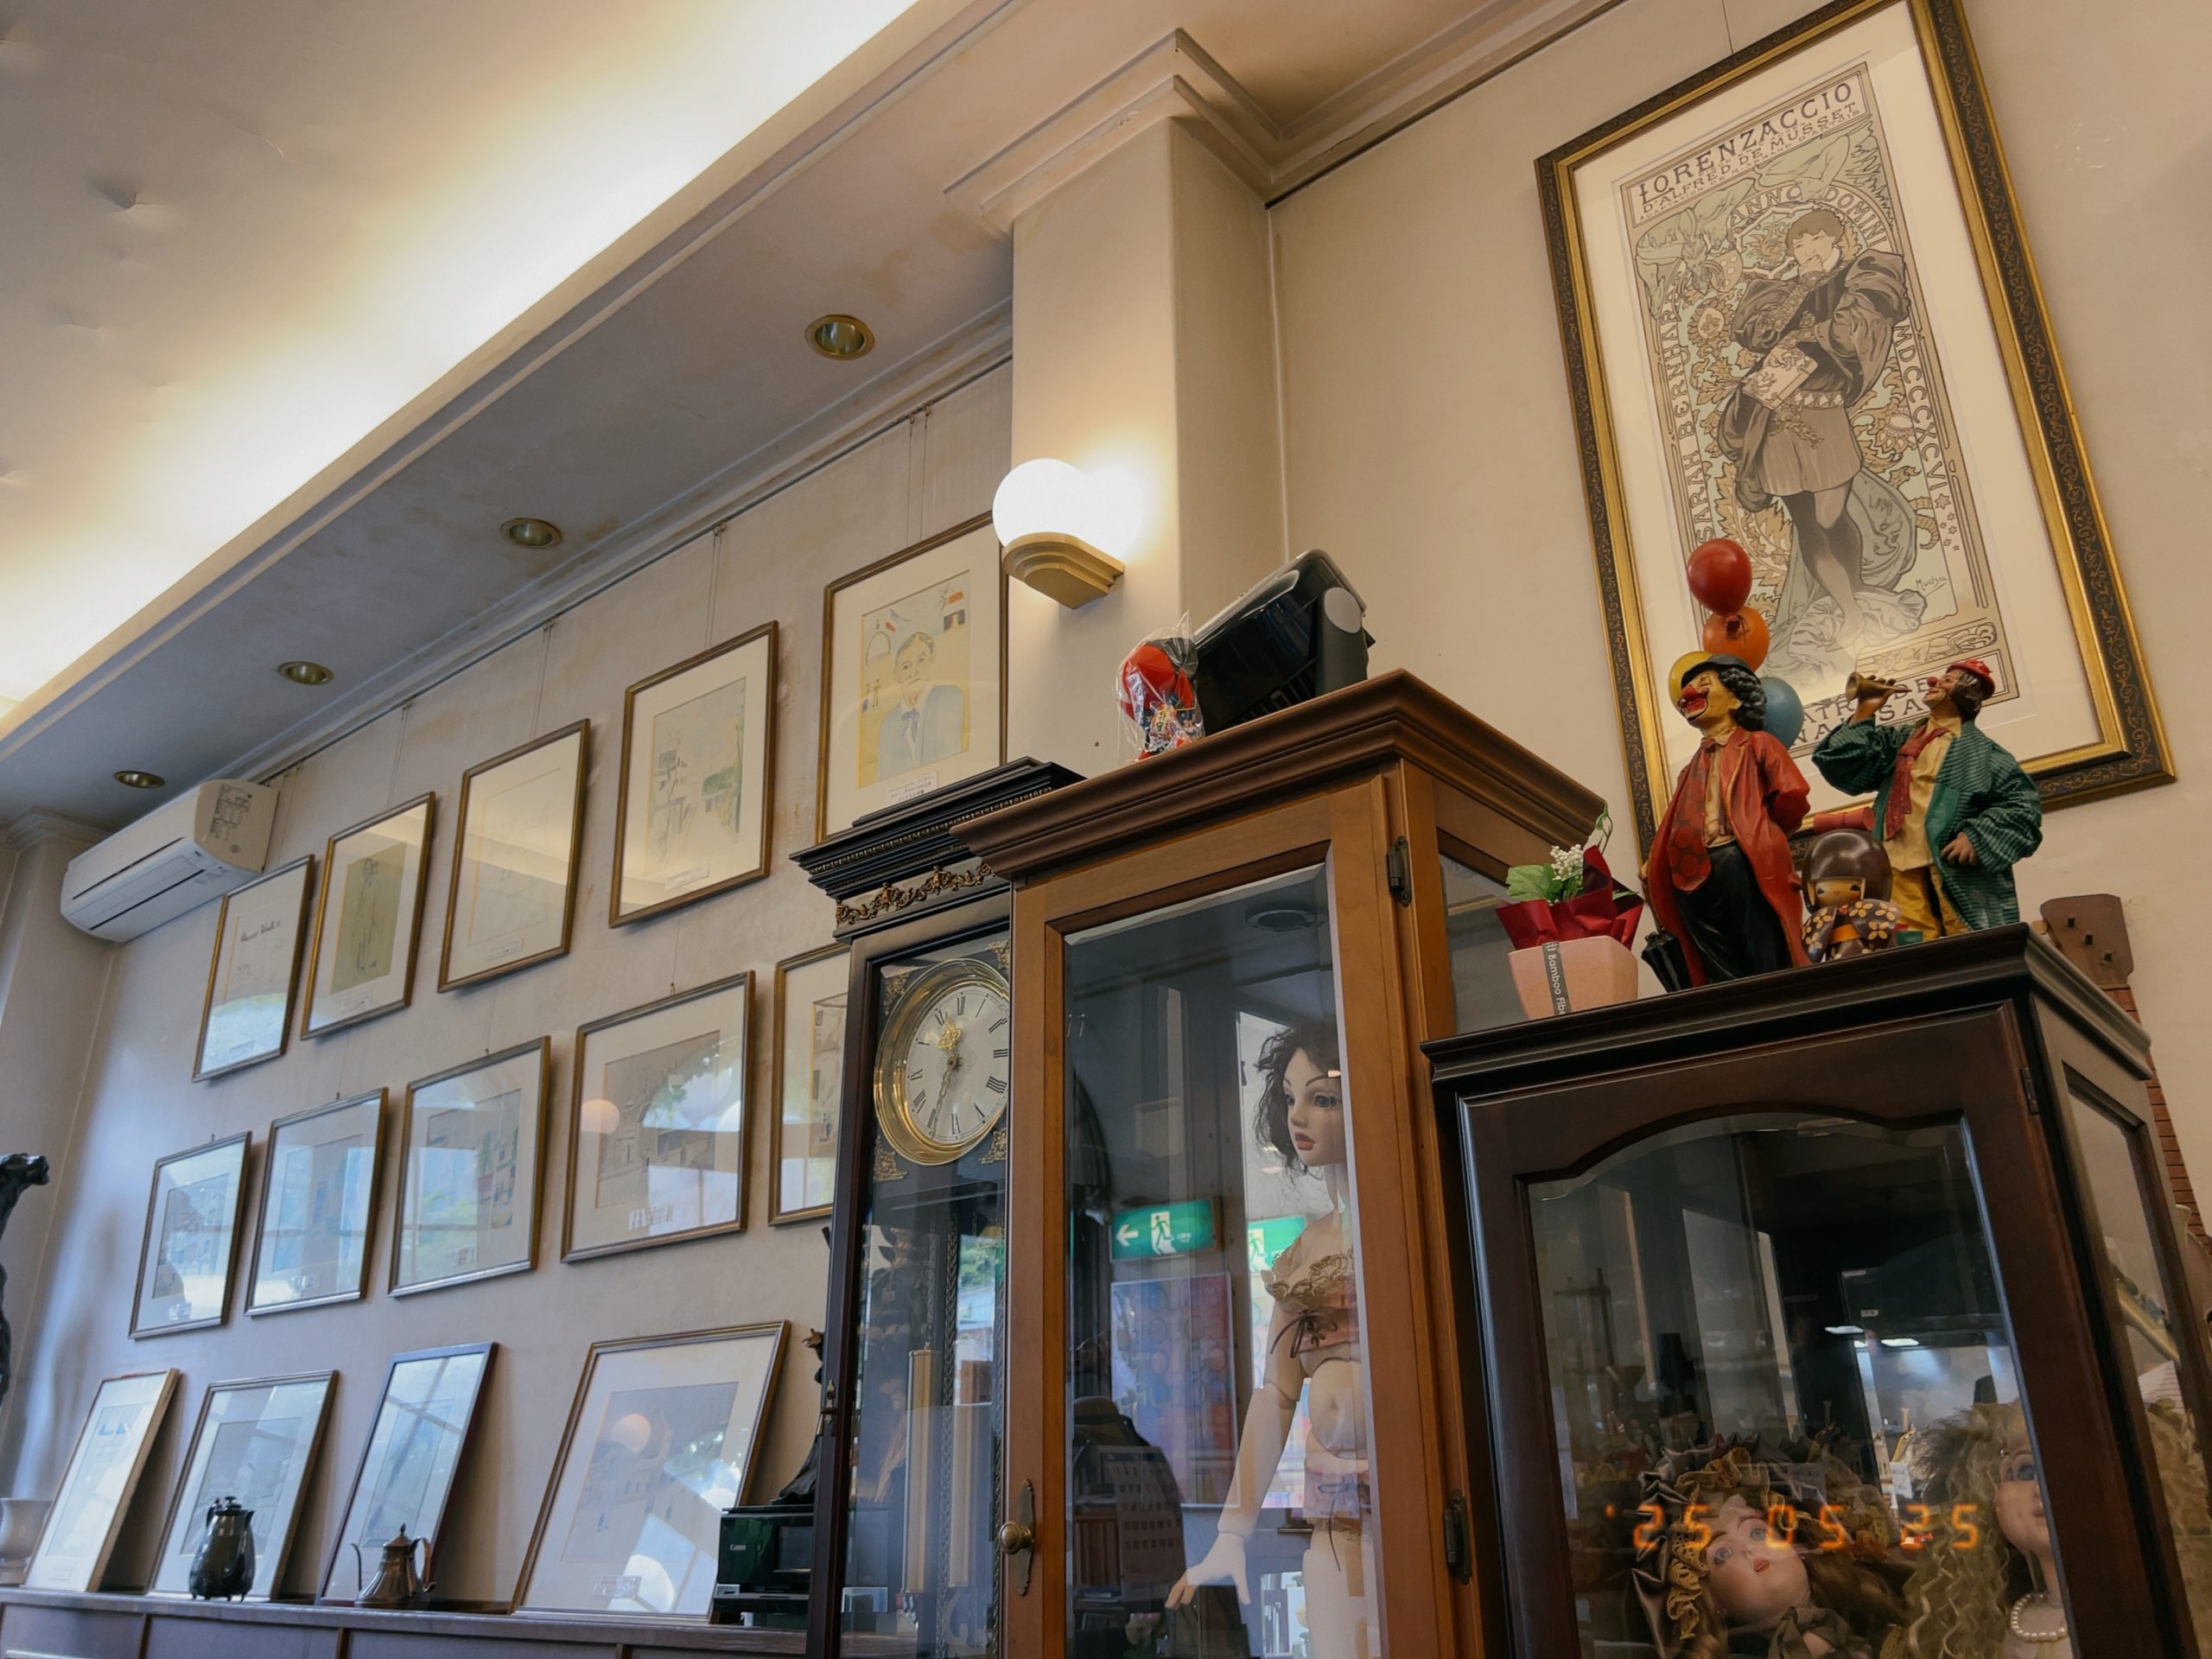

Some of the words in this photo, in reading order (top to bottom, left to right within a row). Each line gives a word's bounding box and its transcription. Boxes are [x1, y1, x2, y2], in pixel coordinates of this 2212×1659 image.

[1638, 82, 1852, 205] LORENZACCIO
[1643, 164, 1731, 213] D'ALFRED
[1739, 148, 1763, 166] DE
[1770, 101, 1856, 150] MUSSET
[1730, 186, 1802, 227] ANNO
[1823, 186, 1888, 248] DOMINI
[1893, 324, 1948, 492] MDCCCXCVI
[1684, 448, 1713, 544] SARAH
[1916, 575, 1948, 591] Mucha
[1548, 953, 1562, 995] Bamboo
[1556, 996, 1567, 1015] Fibe
